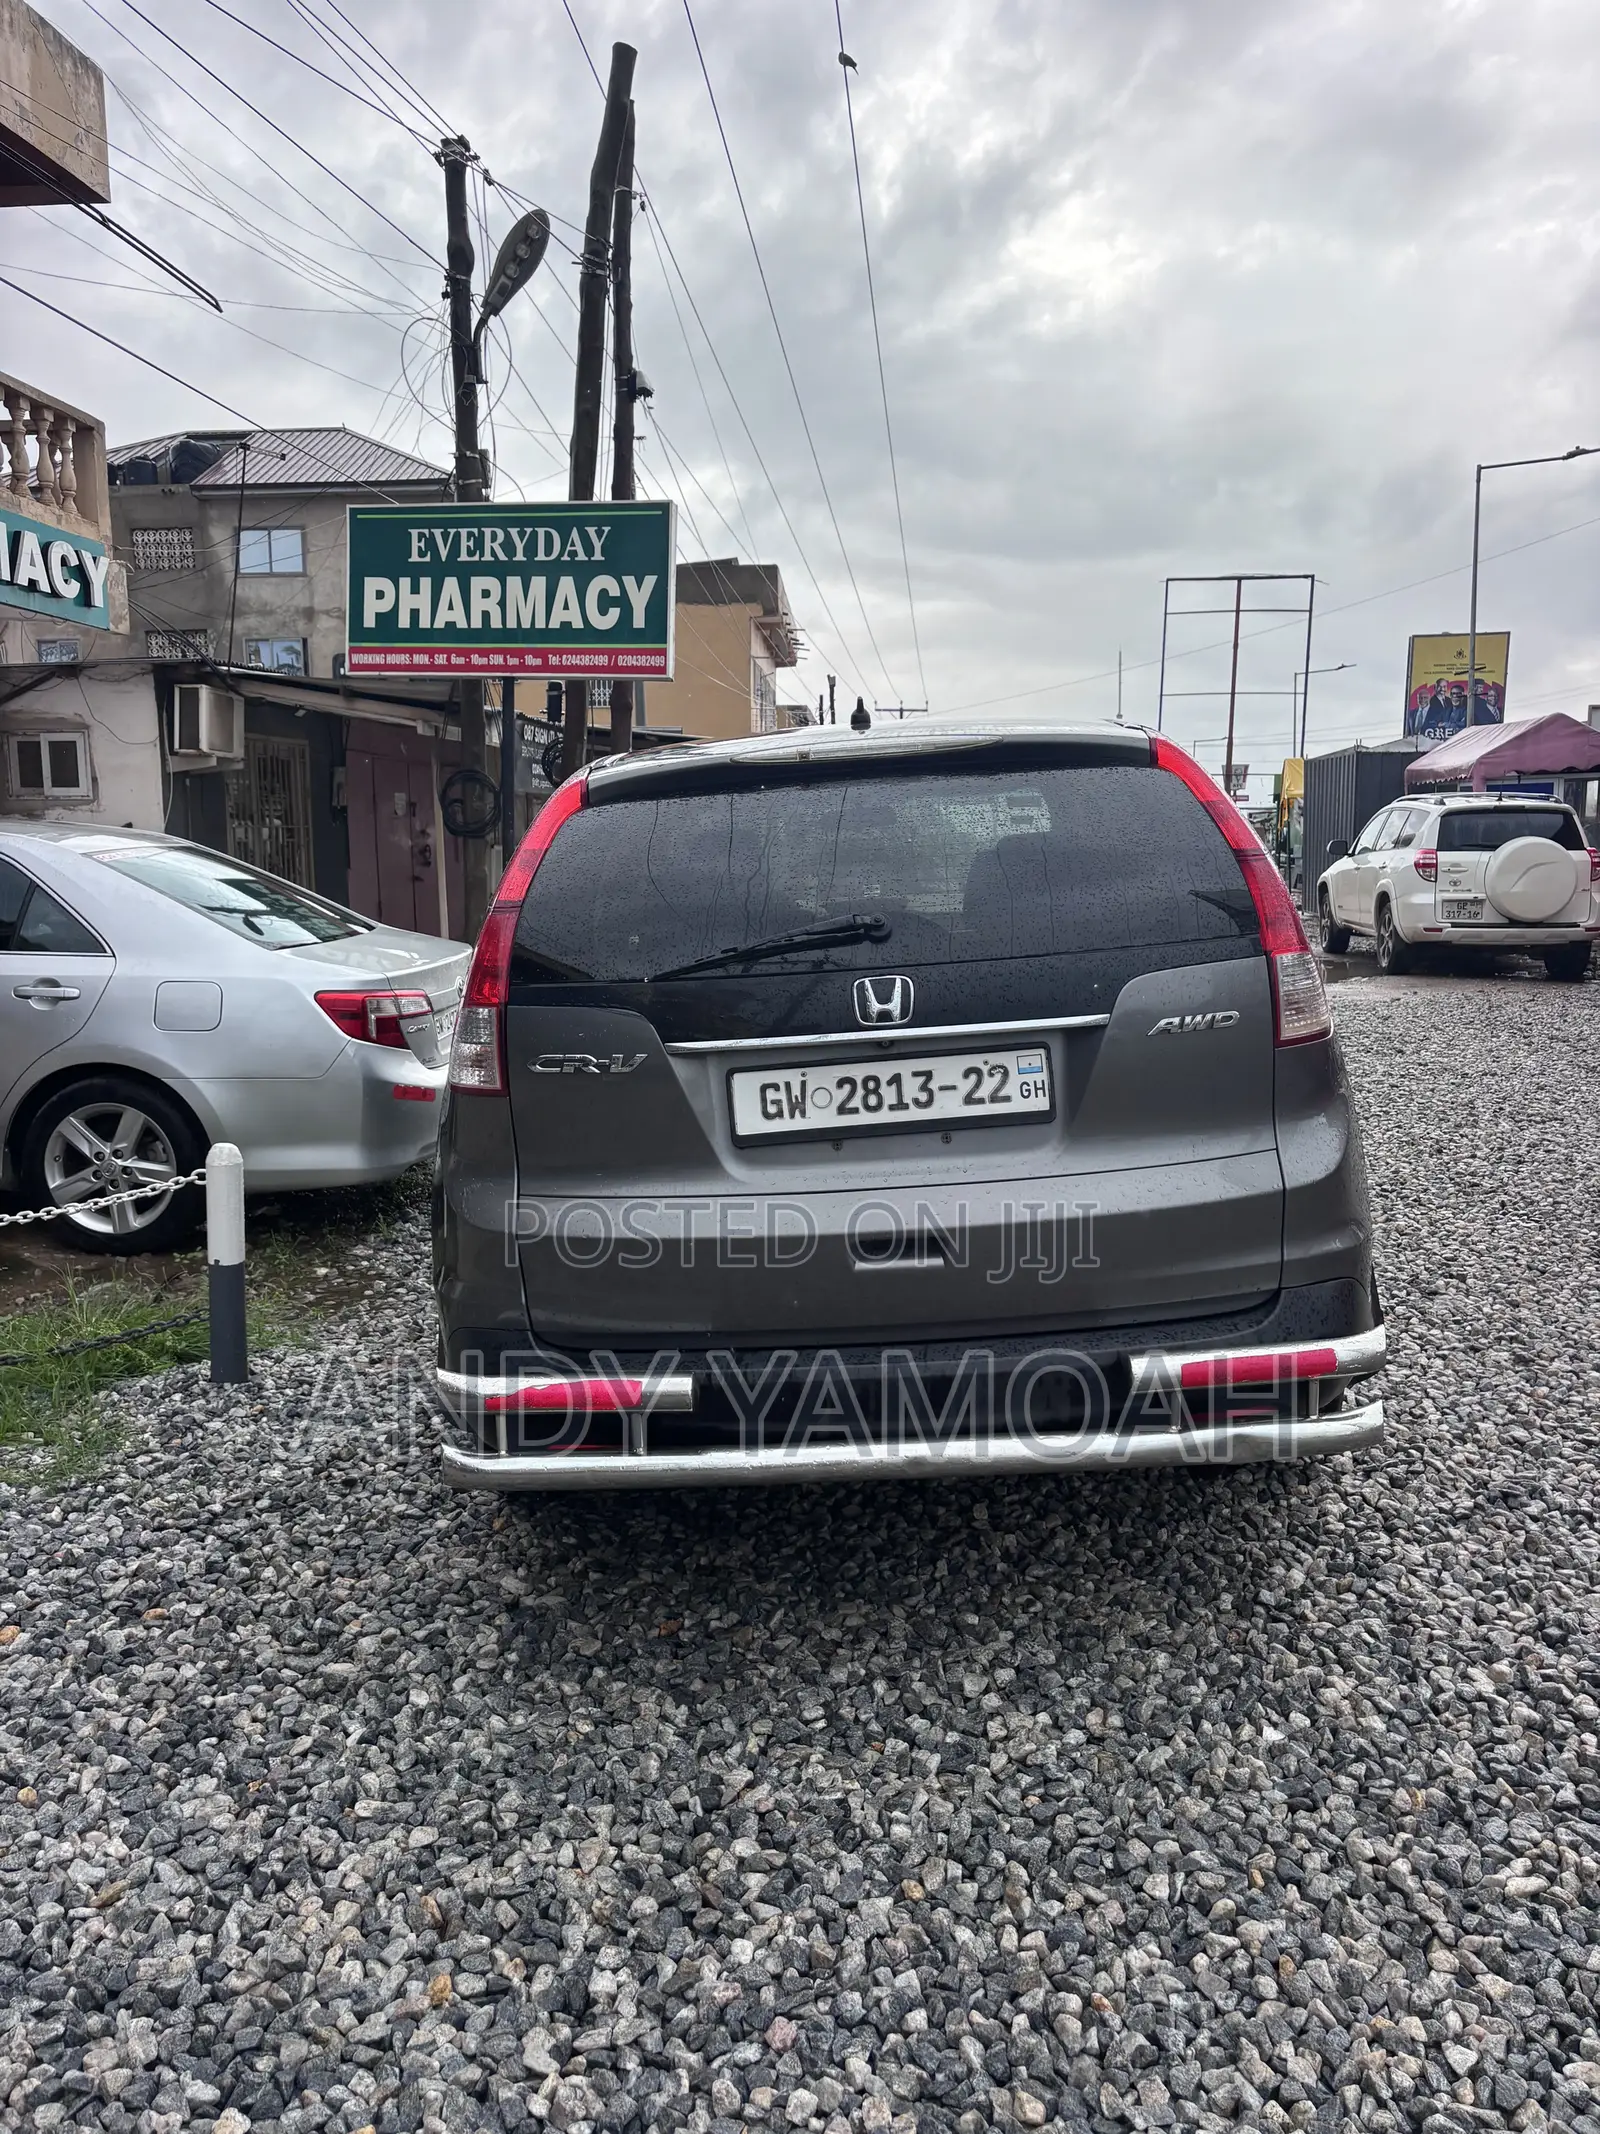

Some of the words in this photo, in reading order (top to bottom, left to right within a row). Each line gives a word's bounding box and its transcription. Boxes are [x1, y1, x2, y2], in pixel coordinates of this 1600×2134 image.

[408, 526, 611, 562] EVERYDAY
[363, 574, 658, 630] PHARMACY
[351, 653, 385, 665] WORKING
[386, 653, 412, 665] HOURS:
[451, 654, 465, 665] 6am
[470, 654, 489, 666] 10pm
[489, 654, 506, 666] SUN.
[507, 654, 519, 666] 1pm
[525, 655, 542, 666] 10pm
[548, 654, 561, 666] Tel:
[1146, 1010, 1240, 1036] AWD
[526, 1053, 648, 1073] CR-V
[759, 1080, 808, 1120] GW
[835, 1064, 1013, 1116] 2813-22
[1019, 1079, 1047, 1099] GH
